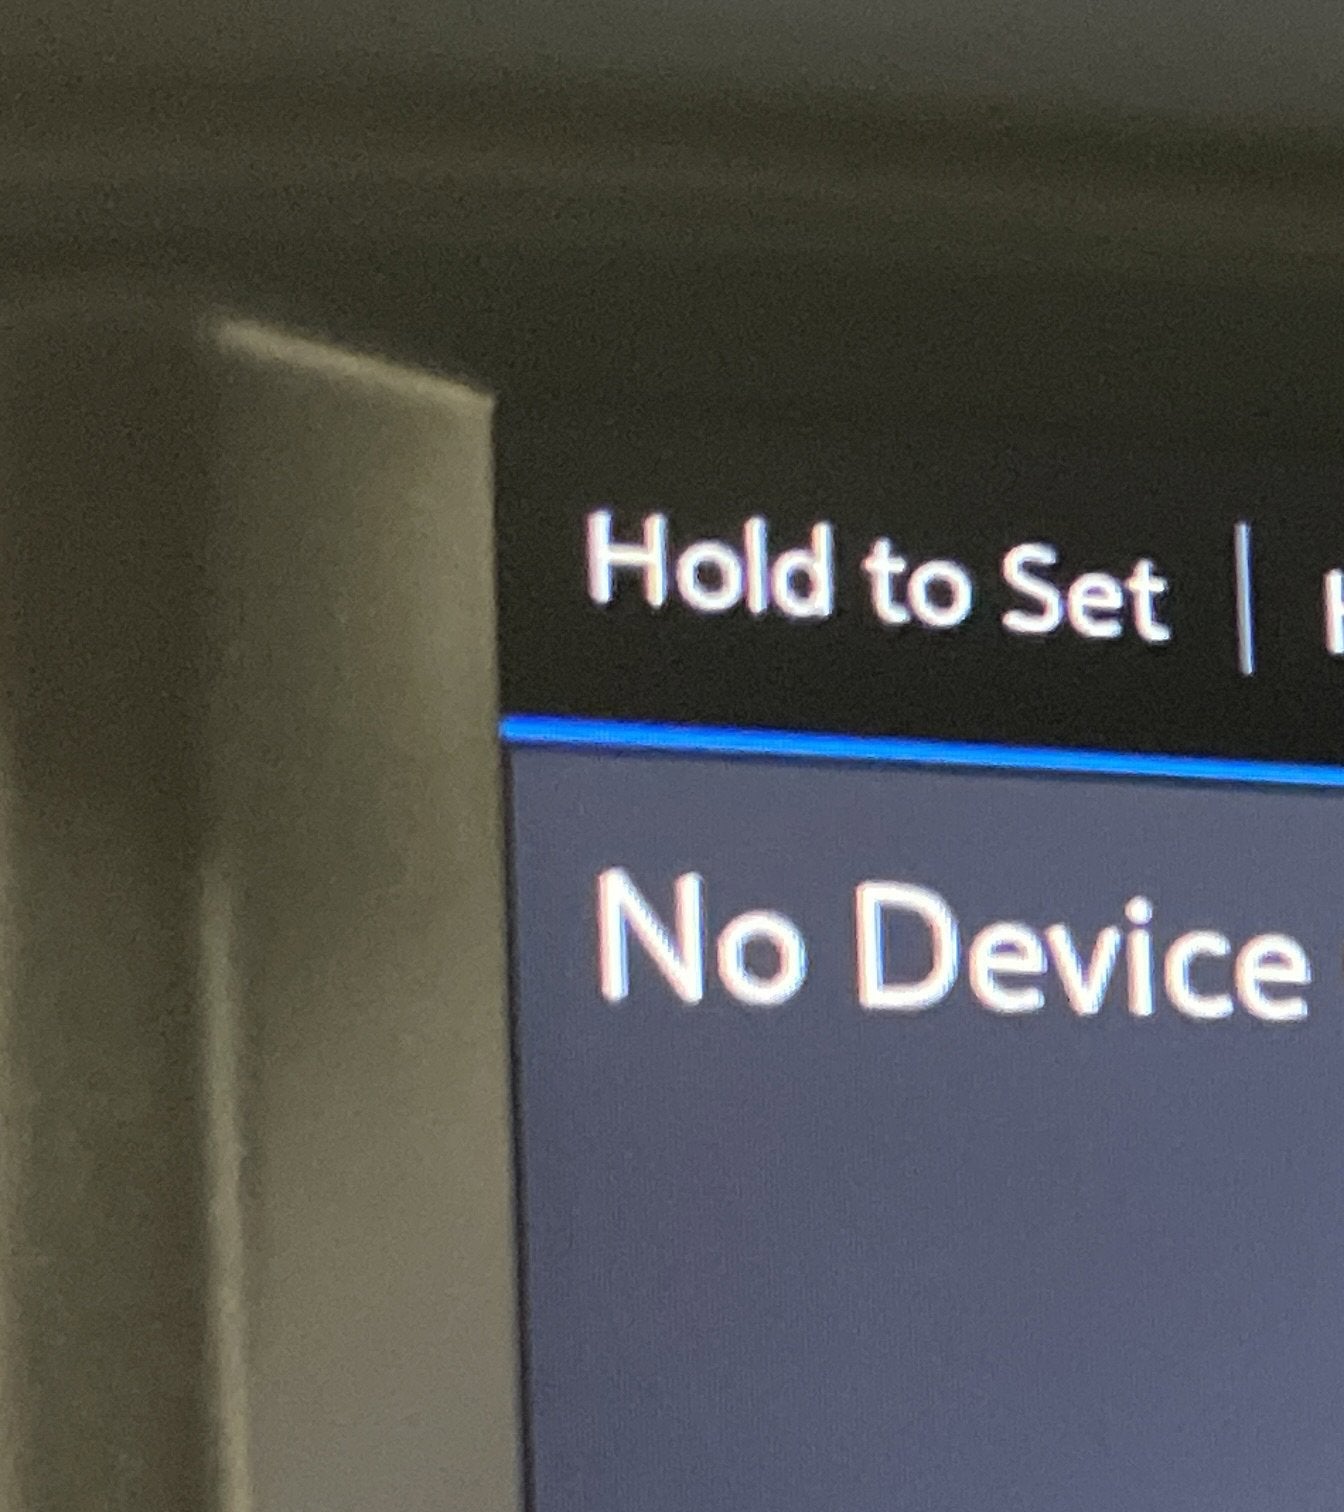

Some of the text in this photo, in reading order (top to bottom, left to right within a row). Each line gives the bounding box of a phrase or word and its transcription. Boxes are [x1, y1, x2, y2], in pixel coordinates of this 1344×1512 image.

[586, 509, 1171, 643] Hold to Set
[597, 867, 807, 1007] No
[854, 879, 1313, 1022] Device
